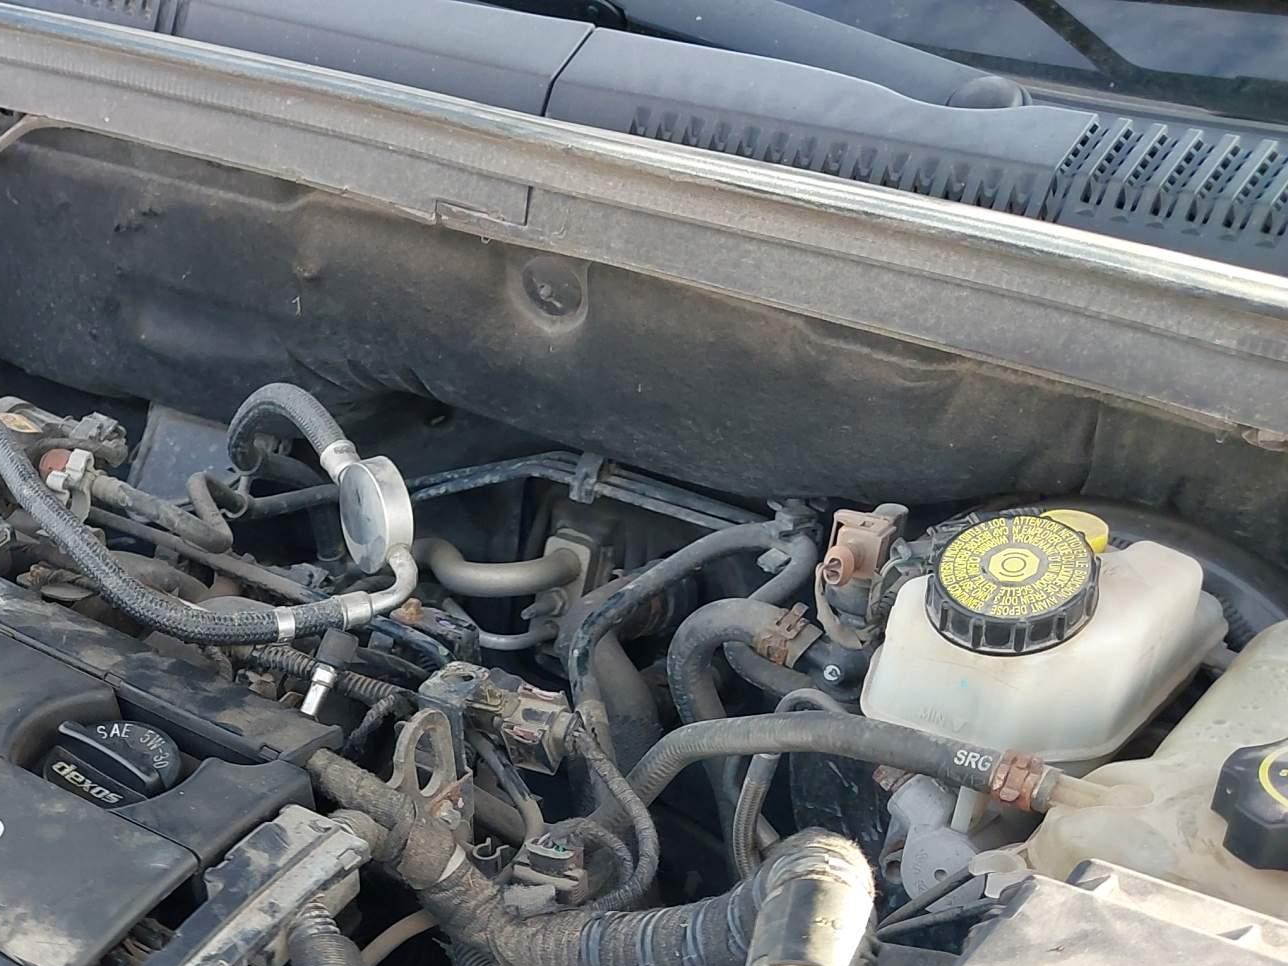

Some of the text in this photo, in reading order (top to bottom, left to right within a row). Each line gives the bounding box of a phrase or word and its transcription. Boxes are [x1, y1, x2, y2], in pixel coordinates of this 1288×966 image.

[986, 517, 1005, 528] DOT
[1014, 515, 1058, 532] ATTENTION
[956, 525, 982, 542] FLUID
[989, 526, 1009, 537] CAP
[942, 538, 965, 558] FROM
[960, 530, 993, 552] BEFORE
[969, 533, 1009, 556] WARNING
[1054, 528, 1089, 558] NETTOYER
[969, 575, 998, 594] FILLER
[996, 584, 1035, 597] SCELLE
[1042, 584, 1060, 596] DE
[969, 587, 991, 601] ONLY
[998, 595, 1017, 605] DOT
[1020, 590, 1047, 604] FREIN
[987, 602, 1028, 616] DEPOSE
[1029, 596, 1061, 613] AVANT
[96, 723, 169, 769] SAE 5W-30
[953, 749, 993, 772] SRG
[52, 761, 123, 803] dexos
